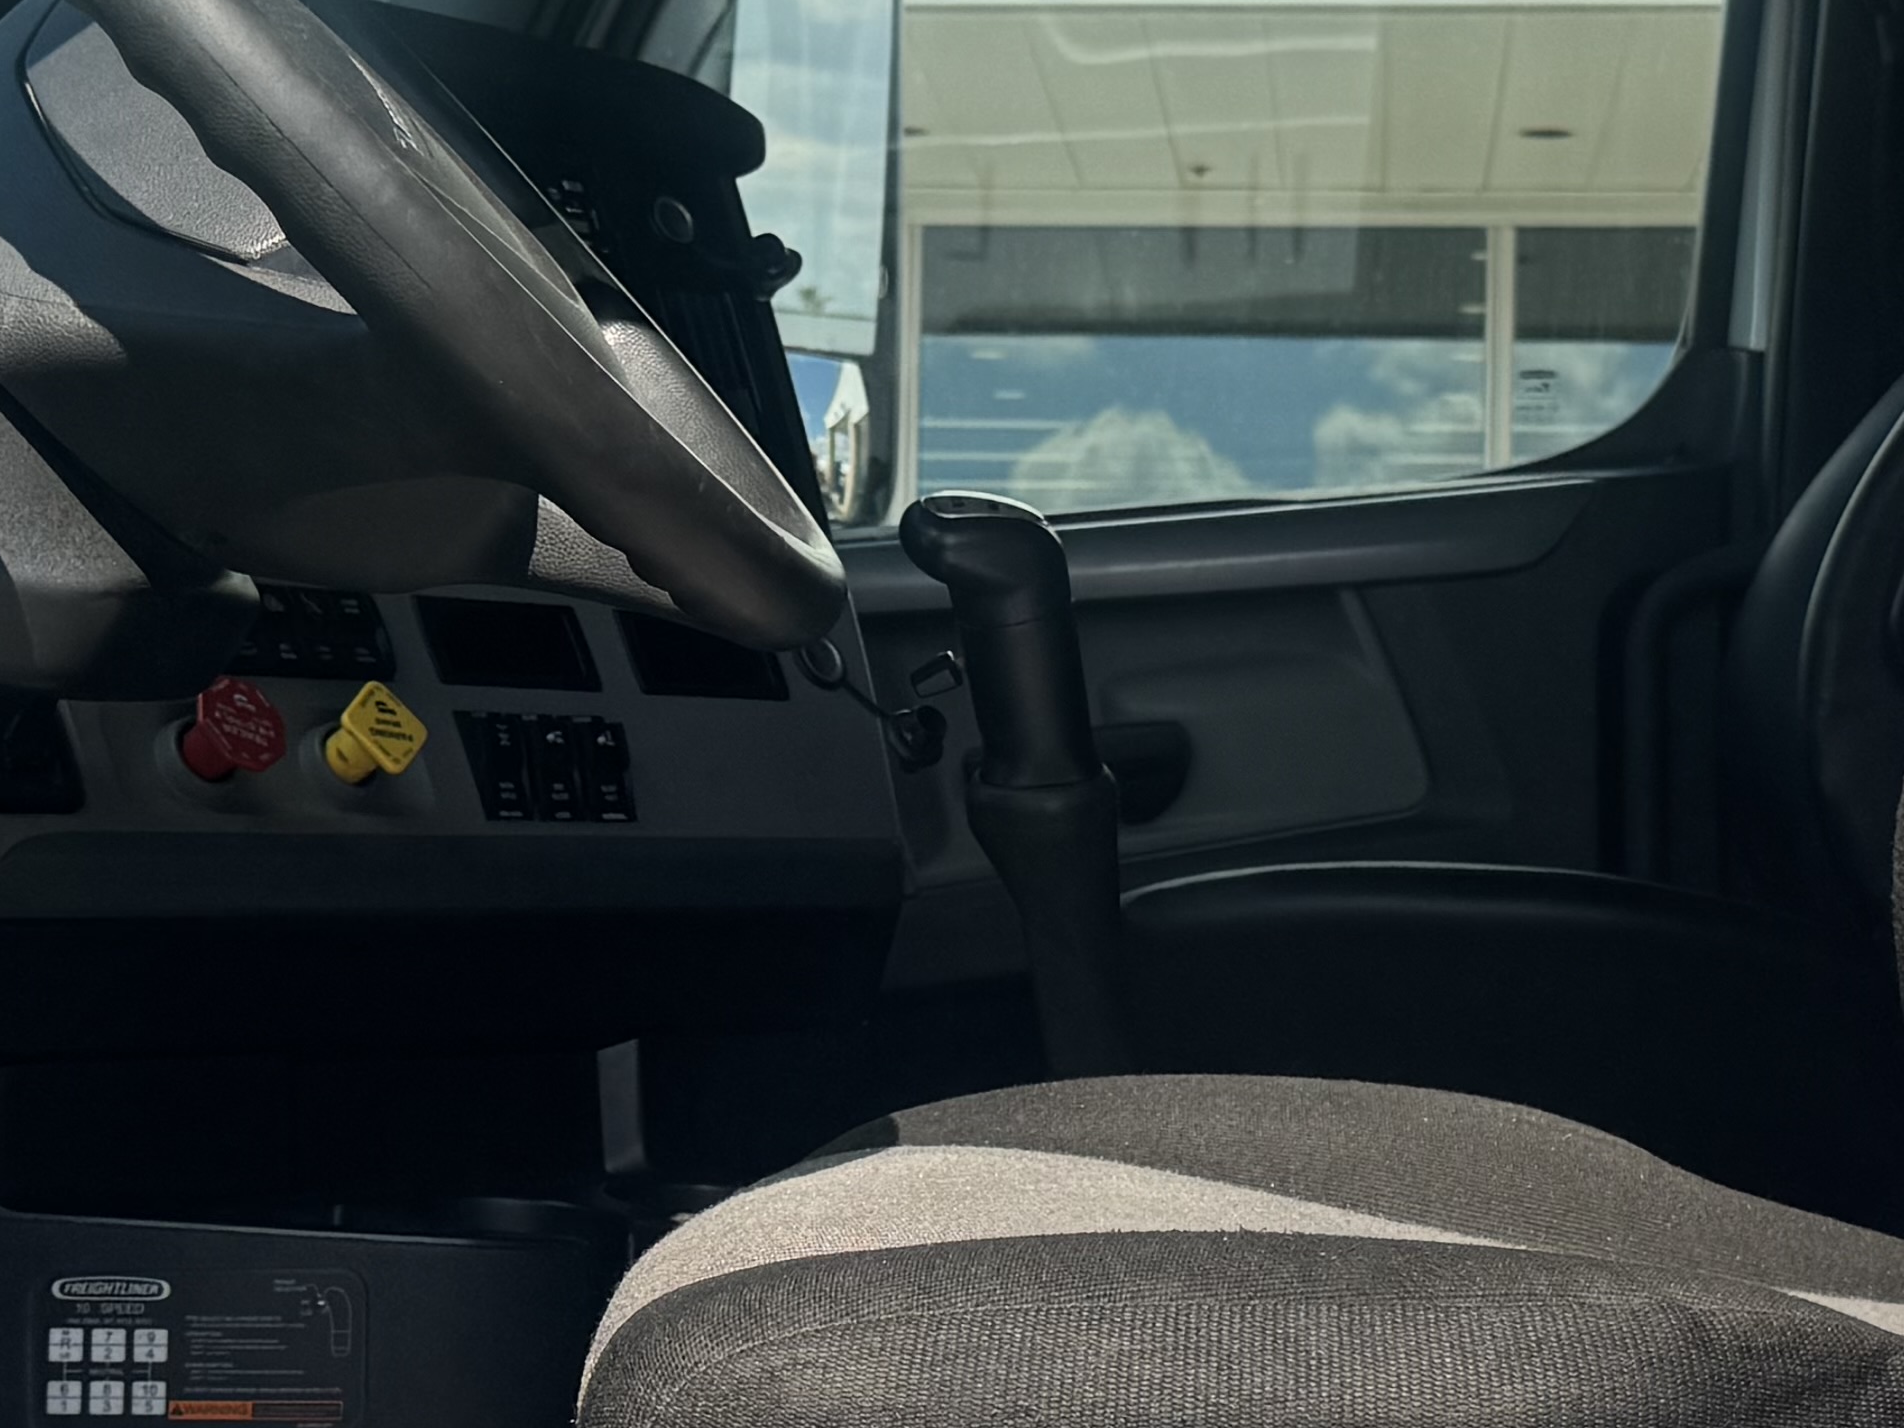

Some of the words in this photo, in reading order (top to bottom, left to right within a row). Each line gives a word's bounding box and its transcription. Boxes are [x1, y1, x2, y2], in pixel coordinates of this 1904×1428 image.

[62, 1281, 160, 1296] FREIGHTLINER
[99, 1302, 145, 1315] SPEED
[104, 1332, 113, 1342] 7
[104, 1348, 113, 1360] 2
[145, 1349, 155, 1360] 4
[142, 1384, 158, 1396] 10
[184, 1403, 246, 1415] WARNING
